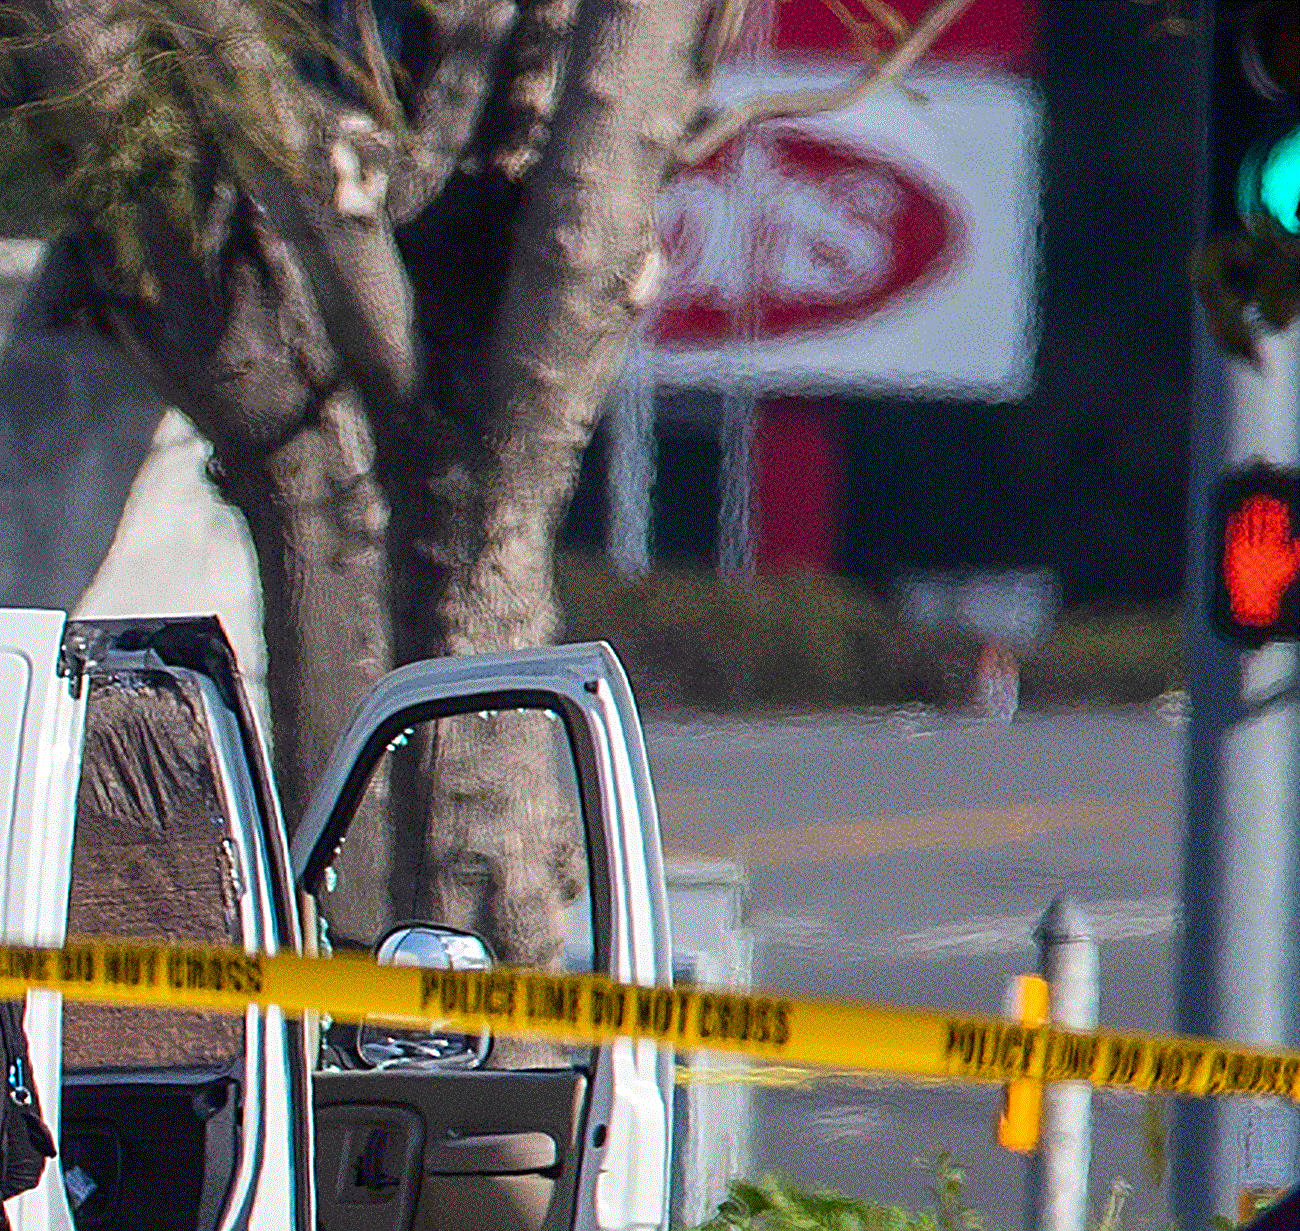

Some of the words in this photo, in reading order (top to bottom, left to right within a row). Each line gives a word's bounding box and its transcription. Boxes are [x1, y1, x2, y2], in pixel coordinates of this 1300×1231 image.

[103, 950, 159, 988] NOT
[167, 953, 263, 994] CROSS
[421, 971, 516, 1016] POLICE
[526, 978, 579, 1024] LINE
[636, 988, 689, 1034] NOT
[697, 995, 789, 1044] CROSS
[947, 1022, 1034, 1071] POLICE
